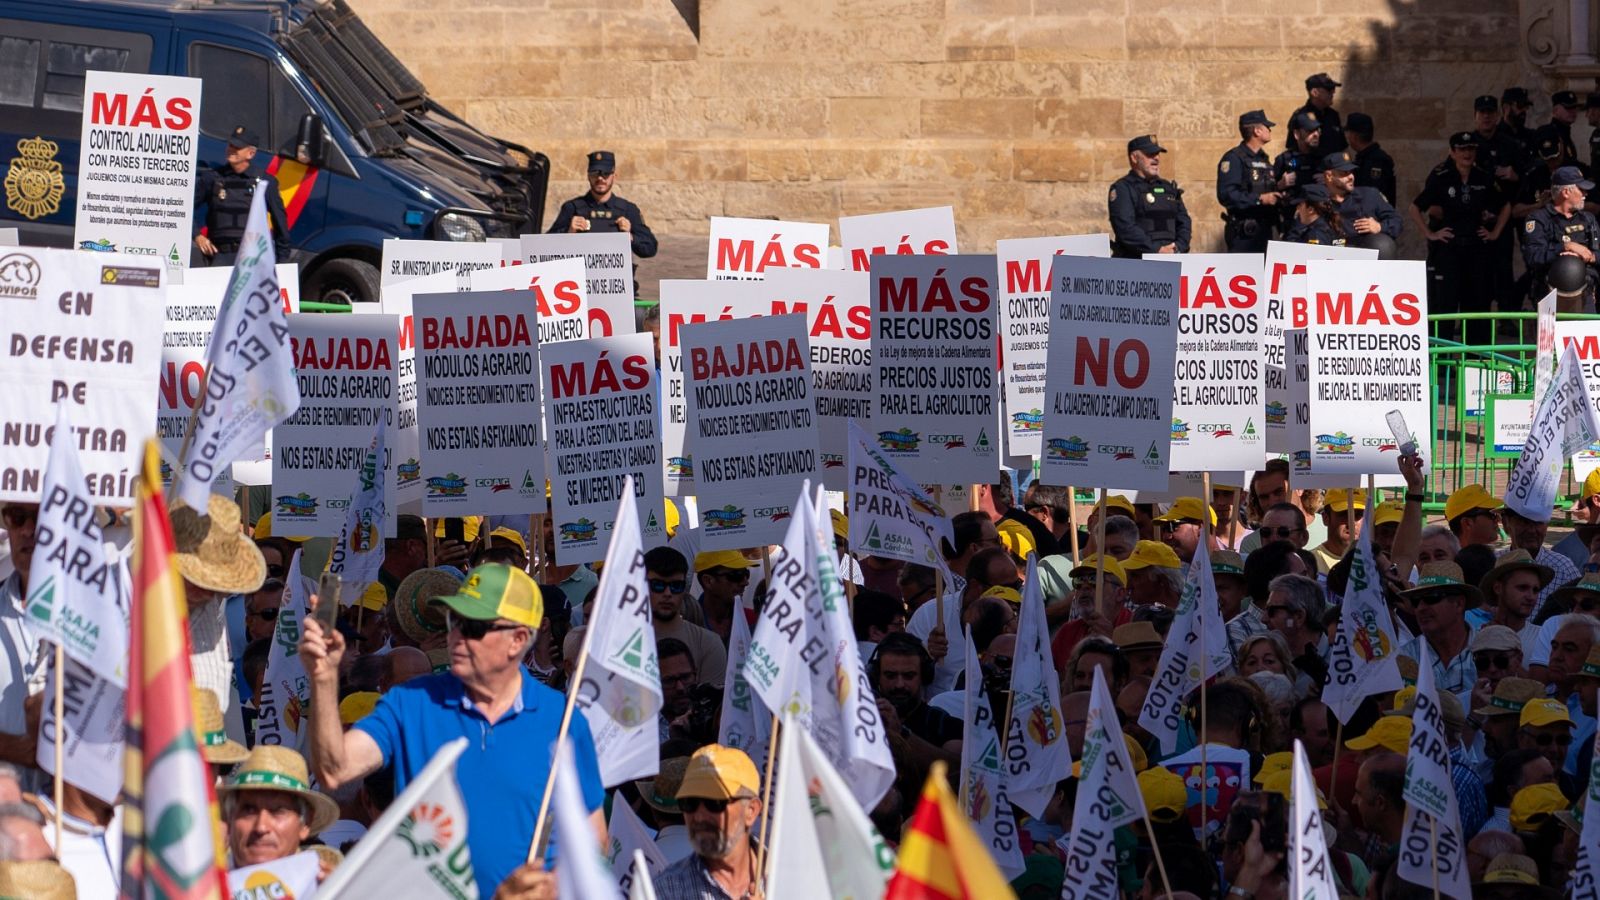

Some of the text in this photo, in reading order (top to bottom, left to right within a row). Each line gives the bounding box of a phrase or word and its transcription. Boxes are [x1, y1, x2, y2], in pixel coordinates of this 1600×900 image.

[91, 87, 192, 131] MÁS
[89, 128, 191, 156] CONTROL ADUANERO
[88, 153, 190, 173] CON PAISES TERCEROS
[86, 172, 188, 188] JUGUEMOS CON LAS MISMAS CARTAS
[588, 253, 625, 270] CAPRICHOSO
[717, 233, 820, 273] MÁS
[402, 261, 430, 276] MINISTRO
[529, 276, 581, 318] ÁS
[592, 279, 626, 295] NO SE JUEGA
[879, 268, 990, 313] MÁS
[1062, 277, 1173, 299] SR. MINISTRO NO SEA CAPRICHOSO
[58, 291, 93, 316] EN
[174, 306, 184, 321] SEA
[185, 305, 216, 320] CAPRICHOSO
[1060, 304, 1171, 326] CON LOS AGRICULTORES NO SE JUEGA
[1316, 284, 1421, 326] MÁS
[809, 295, 871, 340] ÁS
[880, 318, 991, 340] RECURSOS
[1010, 323, 1028, 336] CON
[1178, 313, 1258, 334] CURSOS
[422, 313, 531, 350] BAJADA
[538, 318, 583, 343] DUANERO
[1317, 333, 1421, 351] VERTEDEROS
[10, 333, 133, 364] DEFENSA
[691, 337, 805, 381] BAJADA
[810, 346, 871, 366] EDEROS
[890, 345, 899, 360] Ley
[901, 345, 907, 358] de
[908, 345, 926, 360] mejora
[928, 345, 934, 358] de
[941, 345, 961, 358] Cadena
[962, 344, 991, 358] Alimentaria
[425, 349, 532, 378] MÓDULOS AGRARIO
[550, 350, 650, 399] MÁS
[1074, 336, 1150, 389] NO
[1177, 360, 1258, 380] CIOS JUSTOS
[1318, 353, 1421, 376] DE RESIDUOS AGRÍCOLAS
[340, 376, 391, 399] AGRARIO
[824, 367, 871, 392] AGRÍCOLAS
[880, 366, 991, 389] PRECIOS JUSTOS
[51, 380, 87, 405] DE
[456, 386, 466, 405] DE
[467, 384, 514, 404] RENDIMIENTO
[515, 383, 535, 403] NETO
[695, 376, 806, 410] MÓDULOS AGRARIO
[1181, 386, 1258, 405] EL AGRICULTOR
[1319, 382, 1422, 401] MEJORA EL MEDIAMBIENTE
[312, 407, 372, 426] DE RENDIMIENTO
[553, 393, 653, 425] INFRAESTRUCTURAS
[880, 394, 991, 415] PARA EL AGRICULTOR
[1054, 392, 1161, 420] AL CUADERNO DE CAMPO DIGITAL
[555, 418, 655, 450] PARA LA GESTIÓN DEL AGUA
[729, 415, 740, 435] DE
[741, 410, 790, 434] RENDIMIENTO
[791, 408, 811, 428] NETO
[3, 421, 126, 452] NUETRA
[427, 423, 538, 450] NOS ESTAIS ASFIXIANDO!
[281, 446, 333, 470] NOS ESTAIS
[557, 444, 656, 476] NUESTRAS HUERTAS Y GANADO
[702, 449, 816, 483] NOS ESTAIS ASFIXIANDO!
[567, 475, 614, 506] SE MUEREN
[854, 492, 905, 520] PARA
[884, 533, 912, 546] ASAJA
[37, 525, 107, 596] PARA
[799, 635, 829, 675] EL
